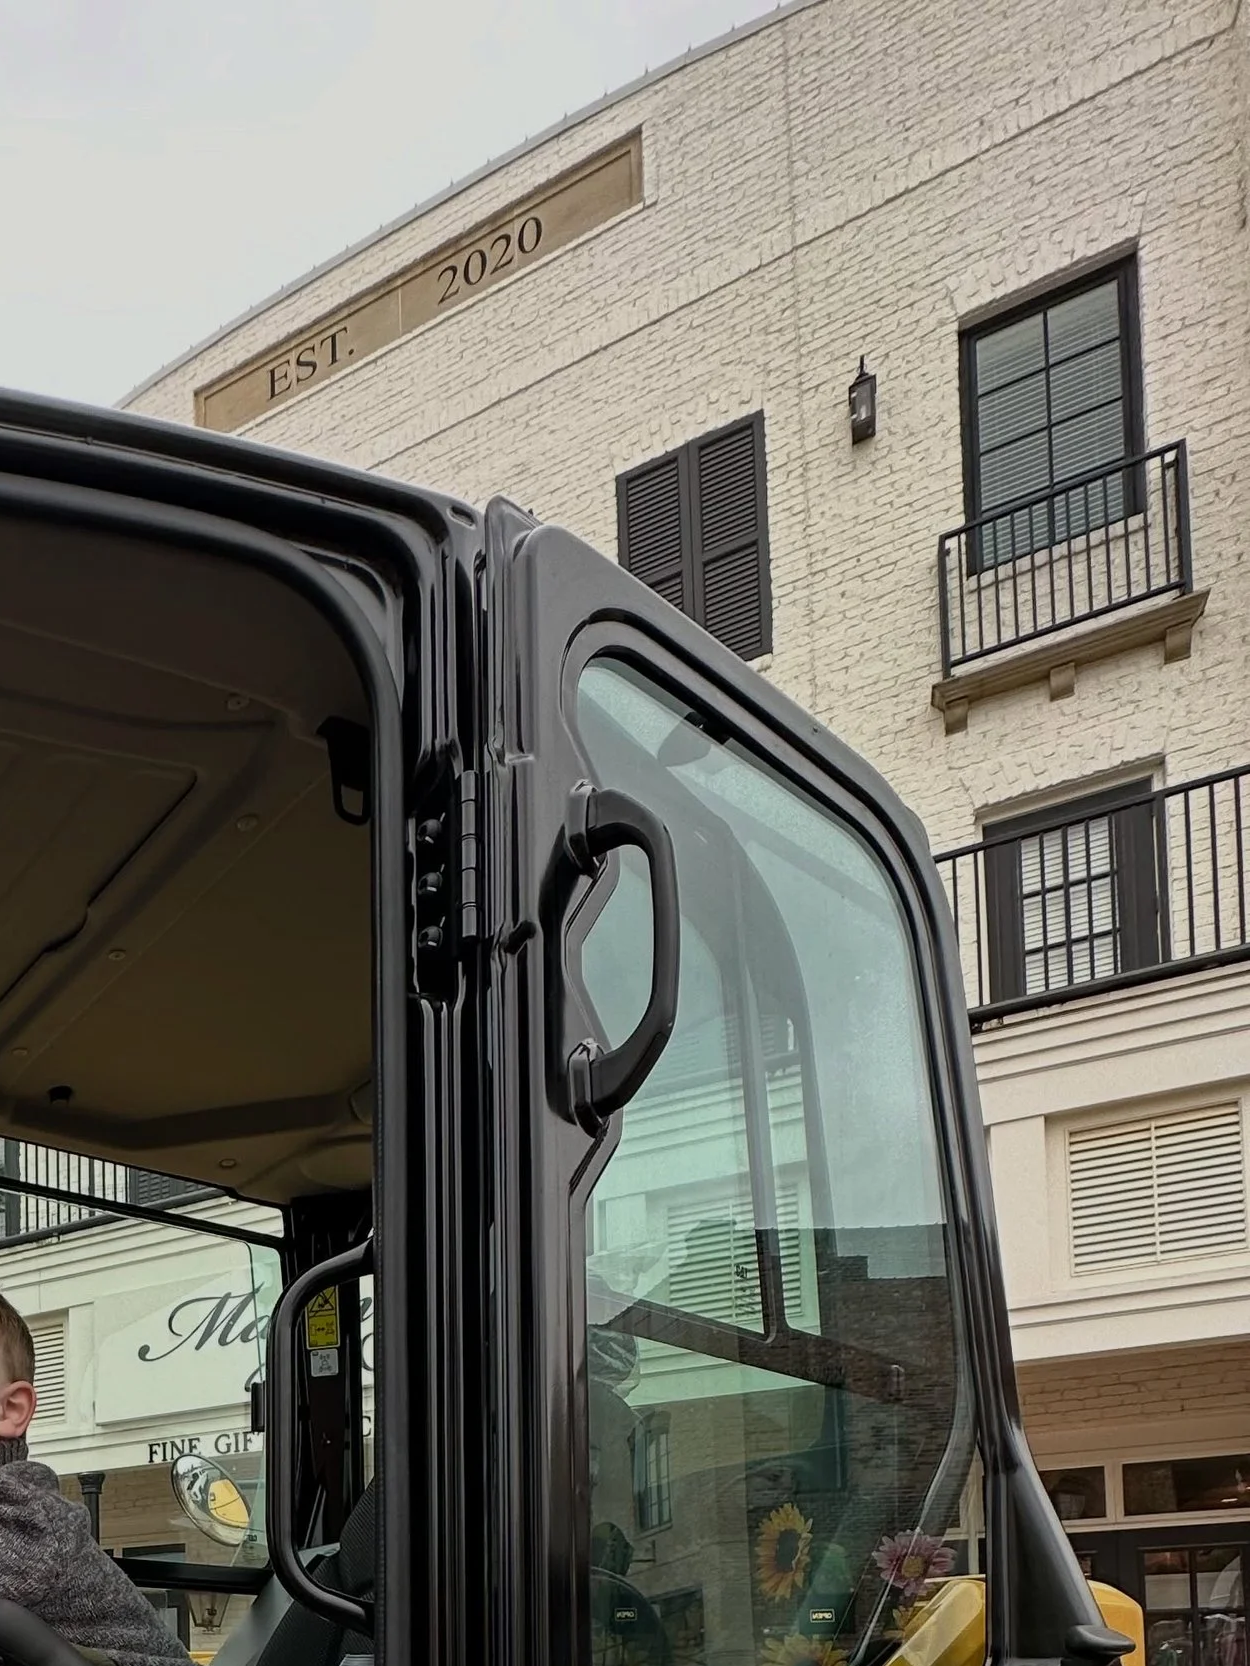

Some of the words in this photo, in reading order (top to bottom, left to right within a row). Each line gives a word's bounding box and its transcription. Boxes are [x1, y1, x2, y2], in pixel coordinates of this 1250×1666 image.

[265, 325, 357, 403] EST.
[437, 215, 544, 305] 2020
[147, 1436, 202, 1464] FINE
[214, 1430, 263, 1455] GIF
